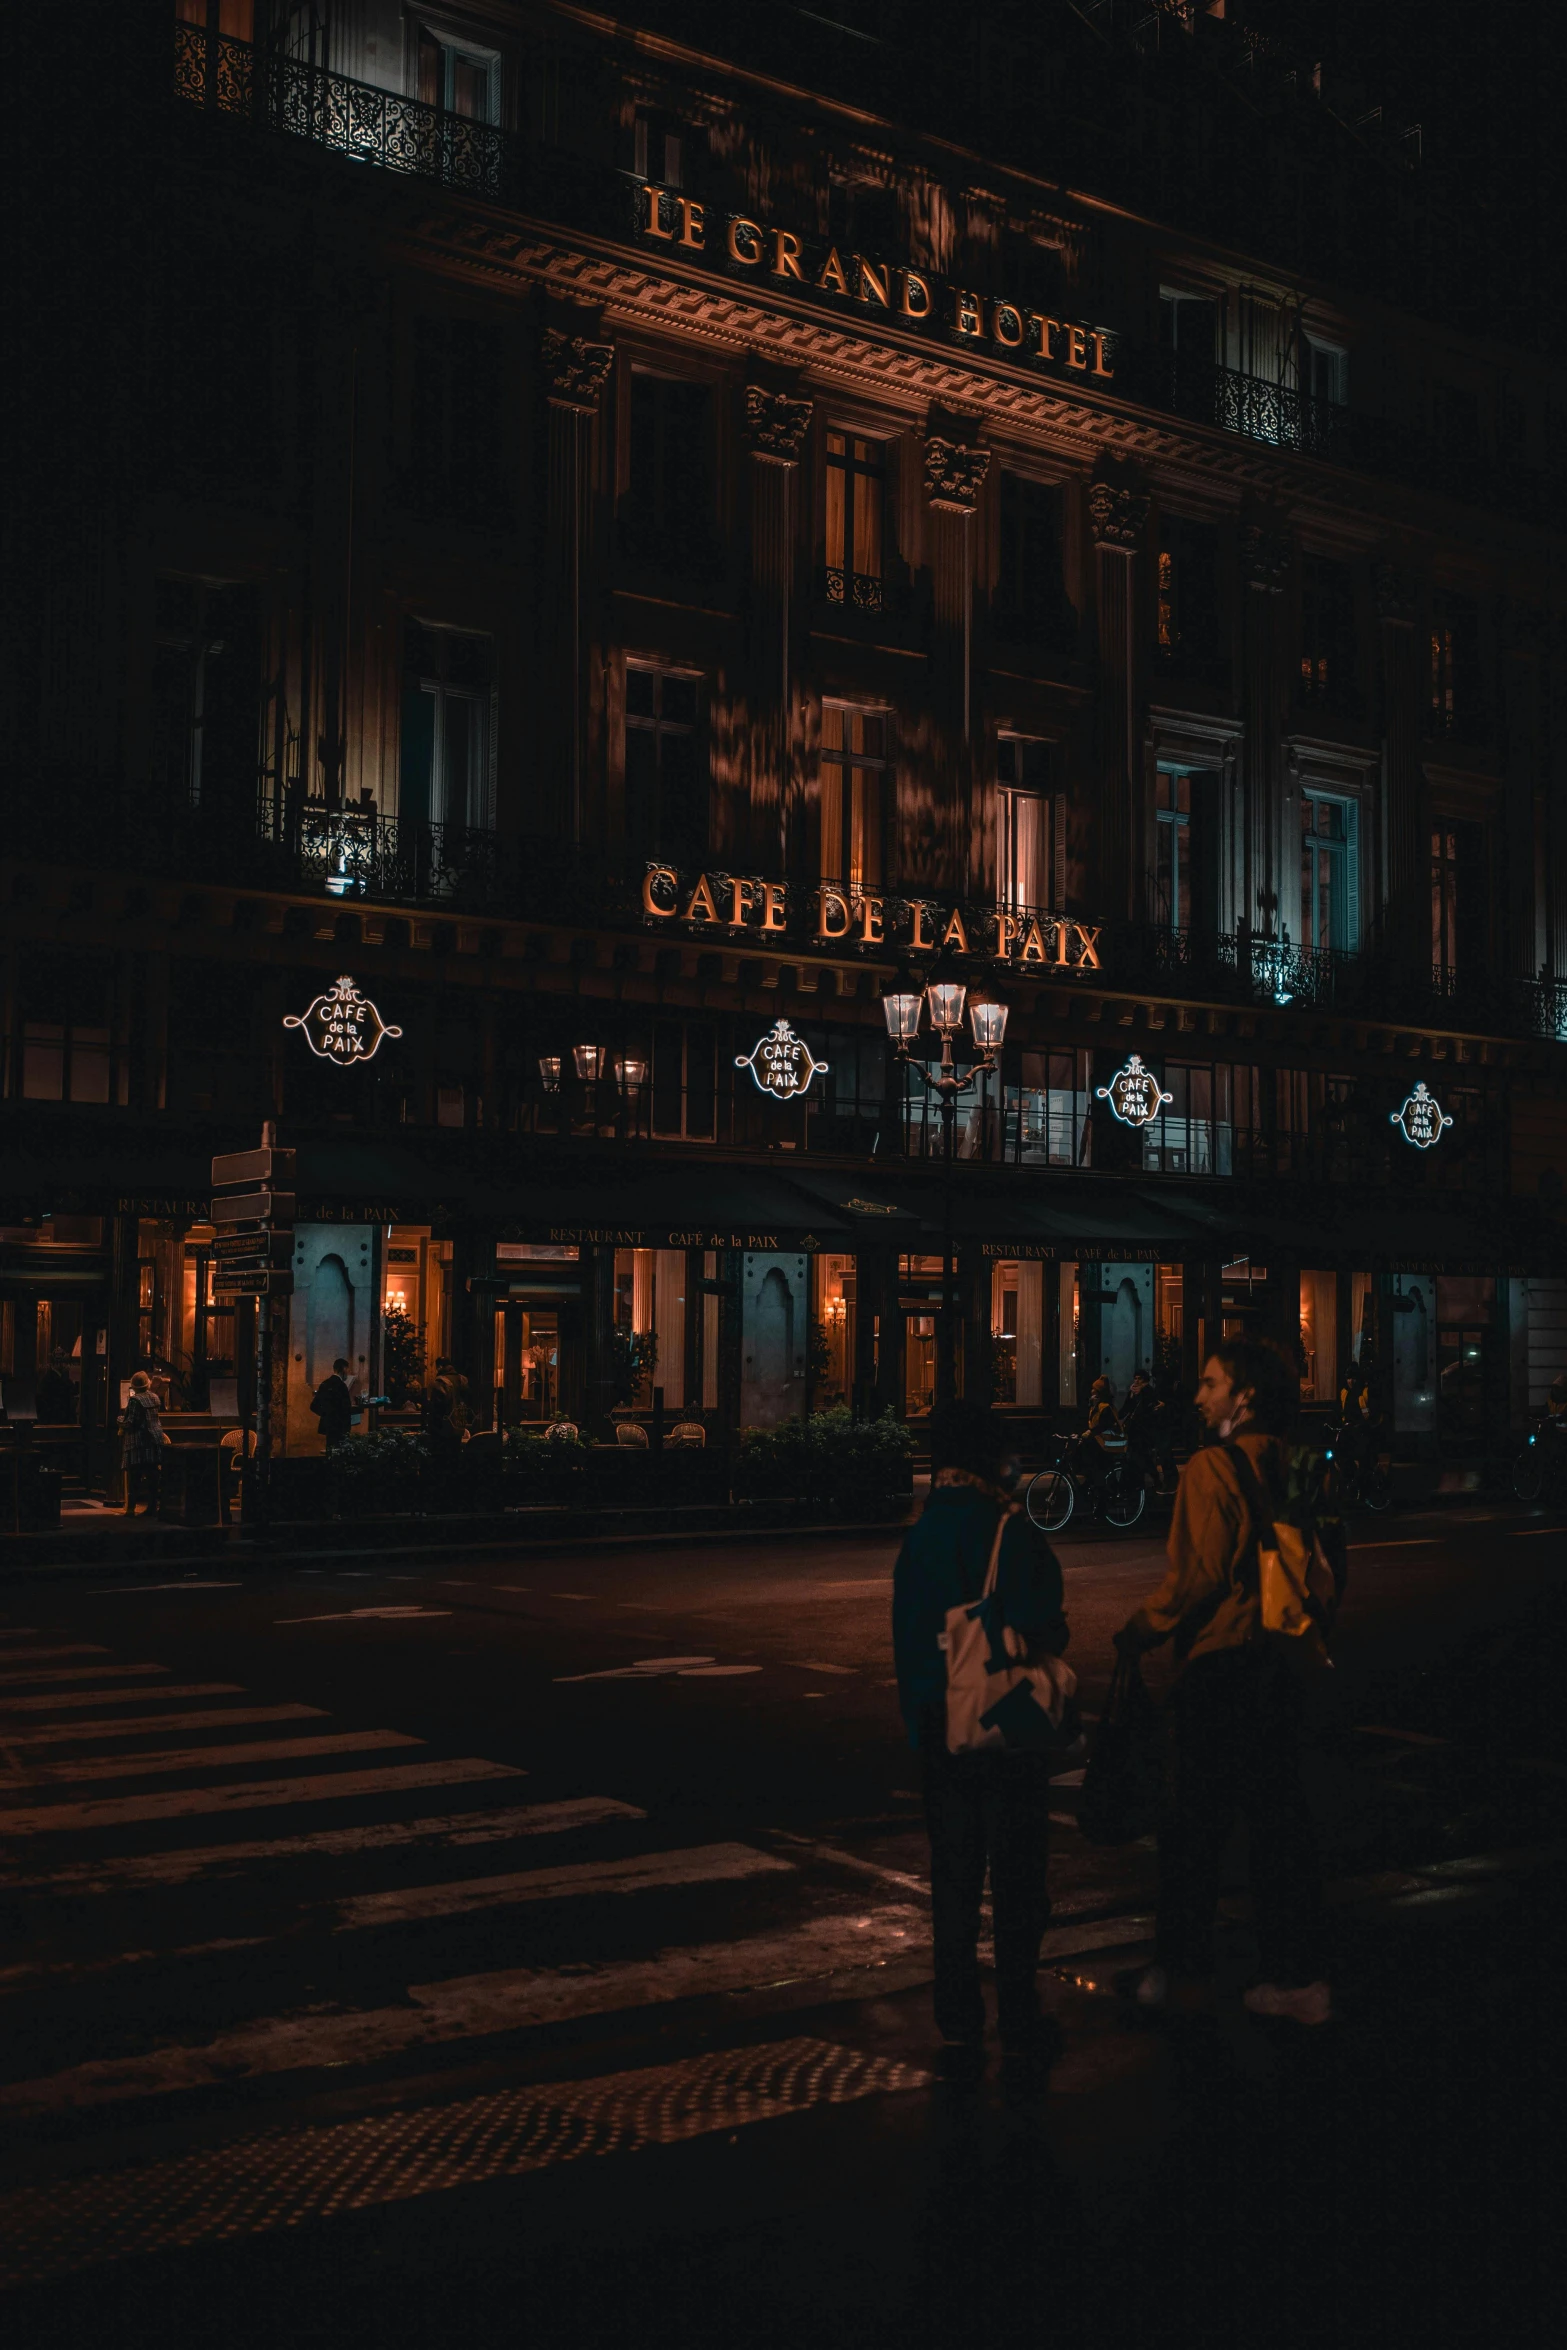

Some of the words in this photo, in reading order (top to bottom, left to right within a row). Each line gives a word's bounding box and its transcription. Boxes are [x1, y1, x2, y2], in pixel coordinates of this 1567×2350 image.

[643, 185, 705, 250] LE
[727, 217, 934, 318] GRAND
[949, 285, 1115, 378] HOTEL
[642, 869, 787, 932] CAFE
[815, 890, 885, 944] DE
[908, 901, 971, 955] LA
[993, 913, 1104, 970] PAIX
[320, 1003, 367, 1022] CAFE
[329, 1021, 344, 1033] de
[346, 1022, 357, 1034] la
[323, 1034, 364, 1052] PAIX
[763, 1044, 801, 1061] CAFE
[770, 1060, 782, 1070] de
[784, 1060, 793, 1071] la
[766, 1071, 799, 1087] PAIX
[1119, 1078, 1149, 1093] CAFE
[1125, 1092, 1135, 1102] de
[1136, 1092, 1144, 1102] la
[1122, 1102, 1149, 1116] PAIX
[1411, 1125, 1433, 1138] PAIX
[118, 1198, 209, 1215] RESTAURA
[315, 1205, 334, 1220] de
[341, 1206, 354, 1220] la
[363, 1207, 400, 1221] PAIX
[549, 1228, 645, 1244] RESTAURANT
[668, 1231, 704, 1247] CAFÉ
[710, 1233, 725, 1247] de
[731, 1234, 742, 1248] la
[748, 1235, 779, 1249] PAIX
[981, 1243, 1056, 1258] RESTAURANT
[1107, 1249, 1119, 1260] de
[1123, 1249, 1132, 1260] la
[1137, 1249, 1161, 1260] PAIX
